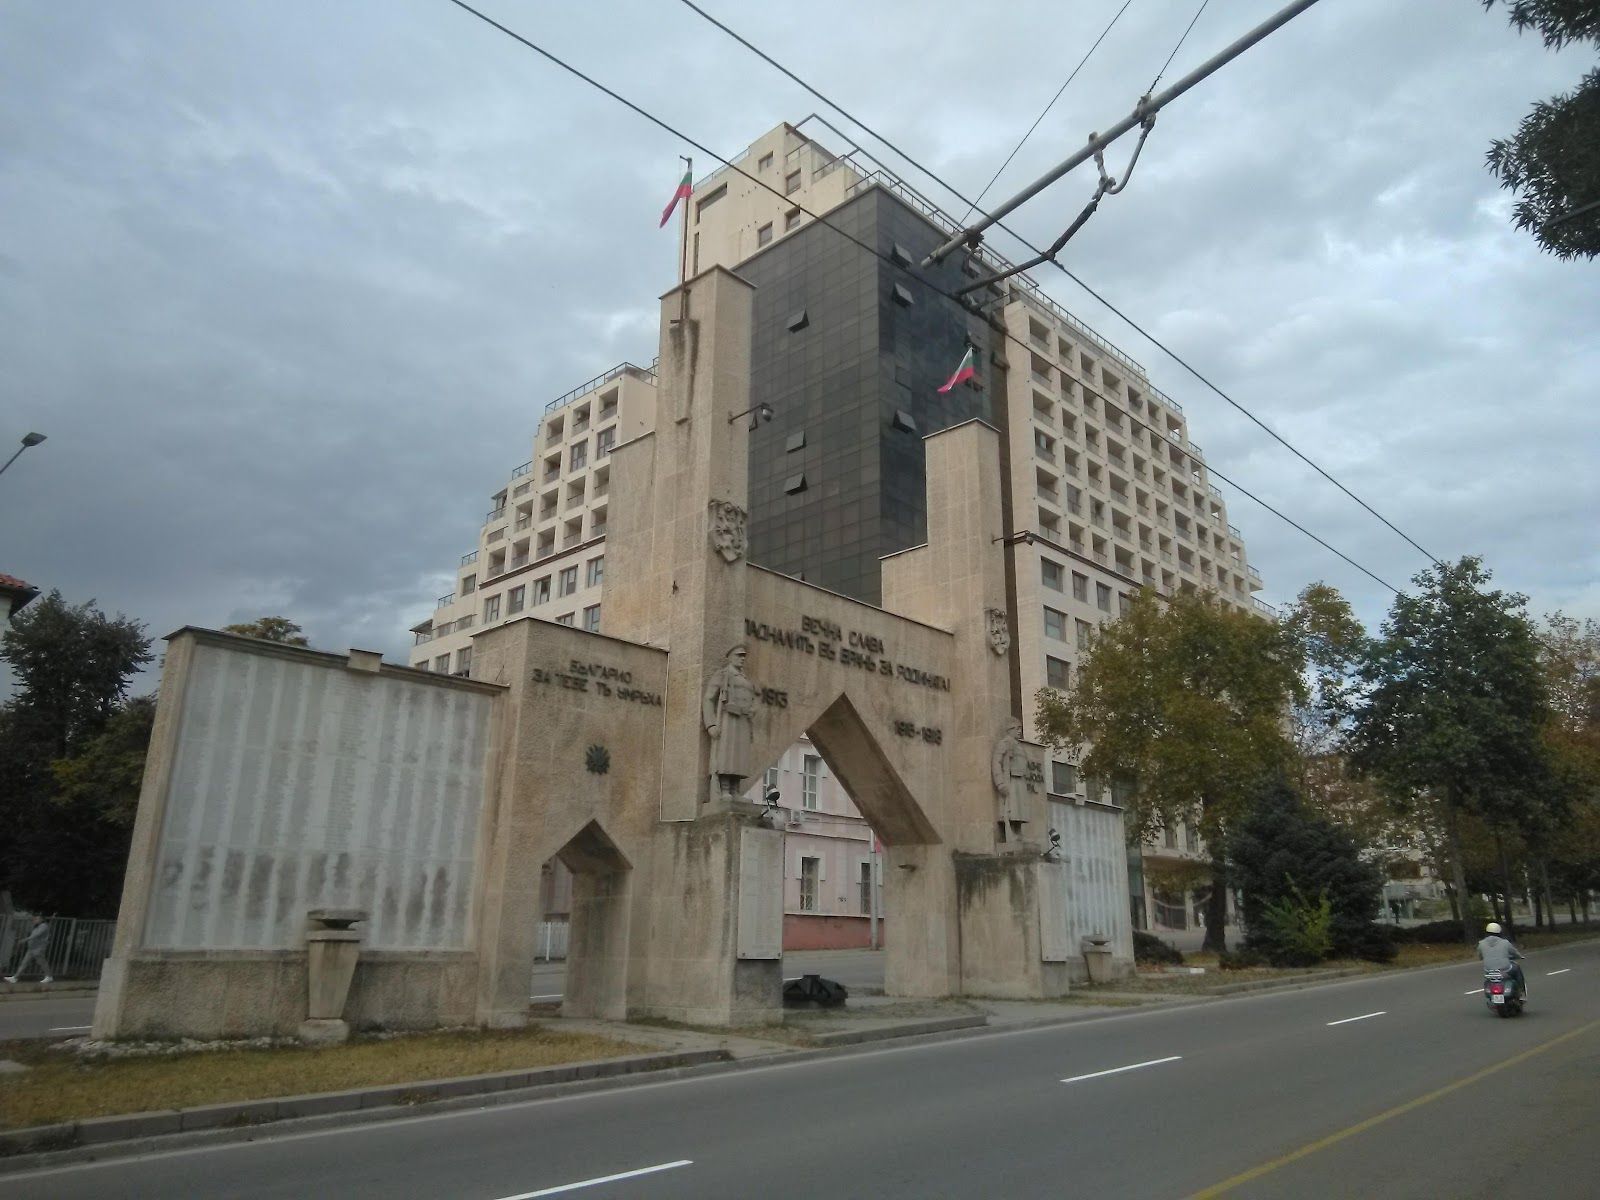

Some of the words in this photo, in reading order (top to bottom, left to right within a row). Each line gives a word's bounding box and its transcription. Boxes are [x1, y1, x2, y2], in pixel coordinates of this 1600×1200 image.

[801, 615, 842, 642] ВЕЧНА
[848, 631, 884, 655] СЛАВА
[530, 668, 551, 684] ЗА
